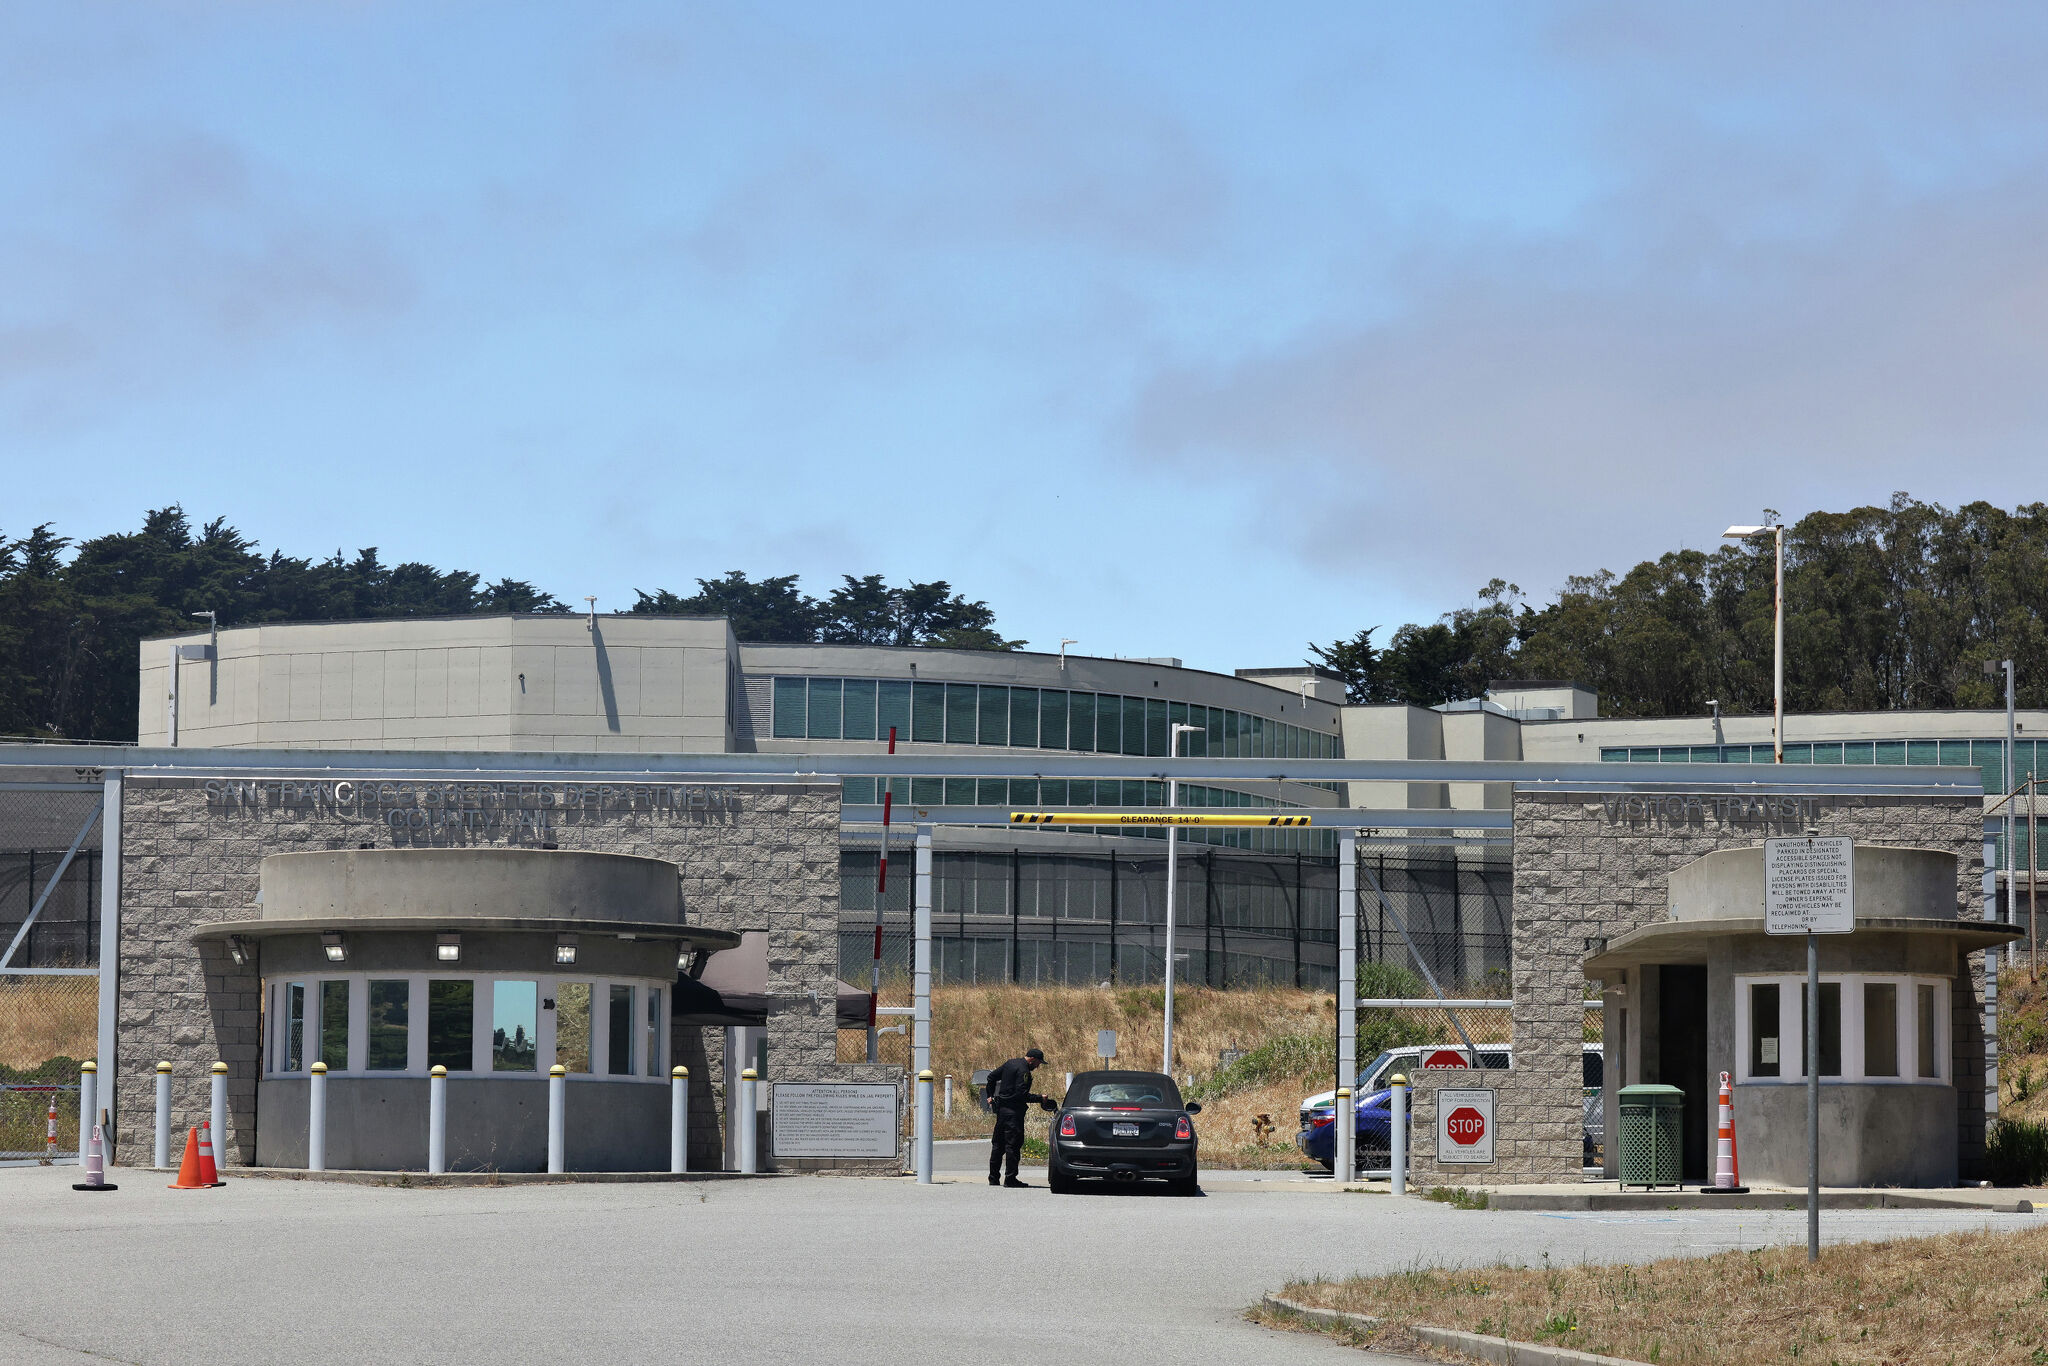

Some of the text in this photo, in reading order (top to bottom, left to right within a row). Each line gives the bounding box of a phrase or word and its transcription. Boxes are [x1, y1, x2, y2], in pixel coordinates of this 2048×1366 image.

[205, 780, 256, 802] SAN
[267, 781, 416, 803] FRANCISCO
[563, 784, 739, 807] DEPARTMENT
[1602, 795, 1819, 817] VISITOR TRANSIT
[387, 808, 496, 830] COUNTY
[1449, 1119, 1483, 1133] STOP
